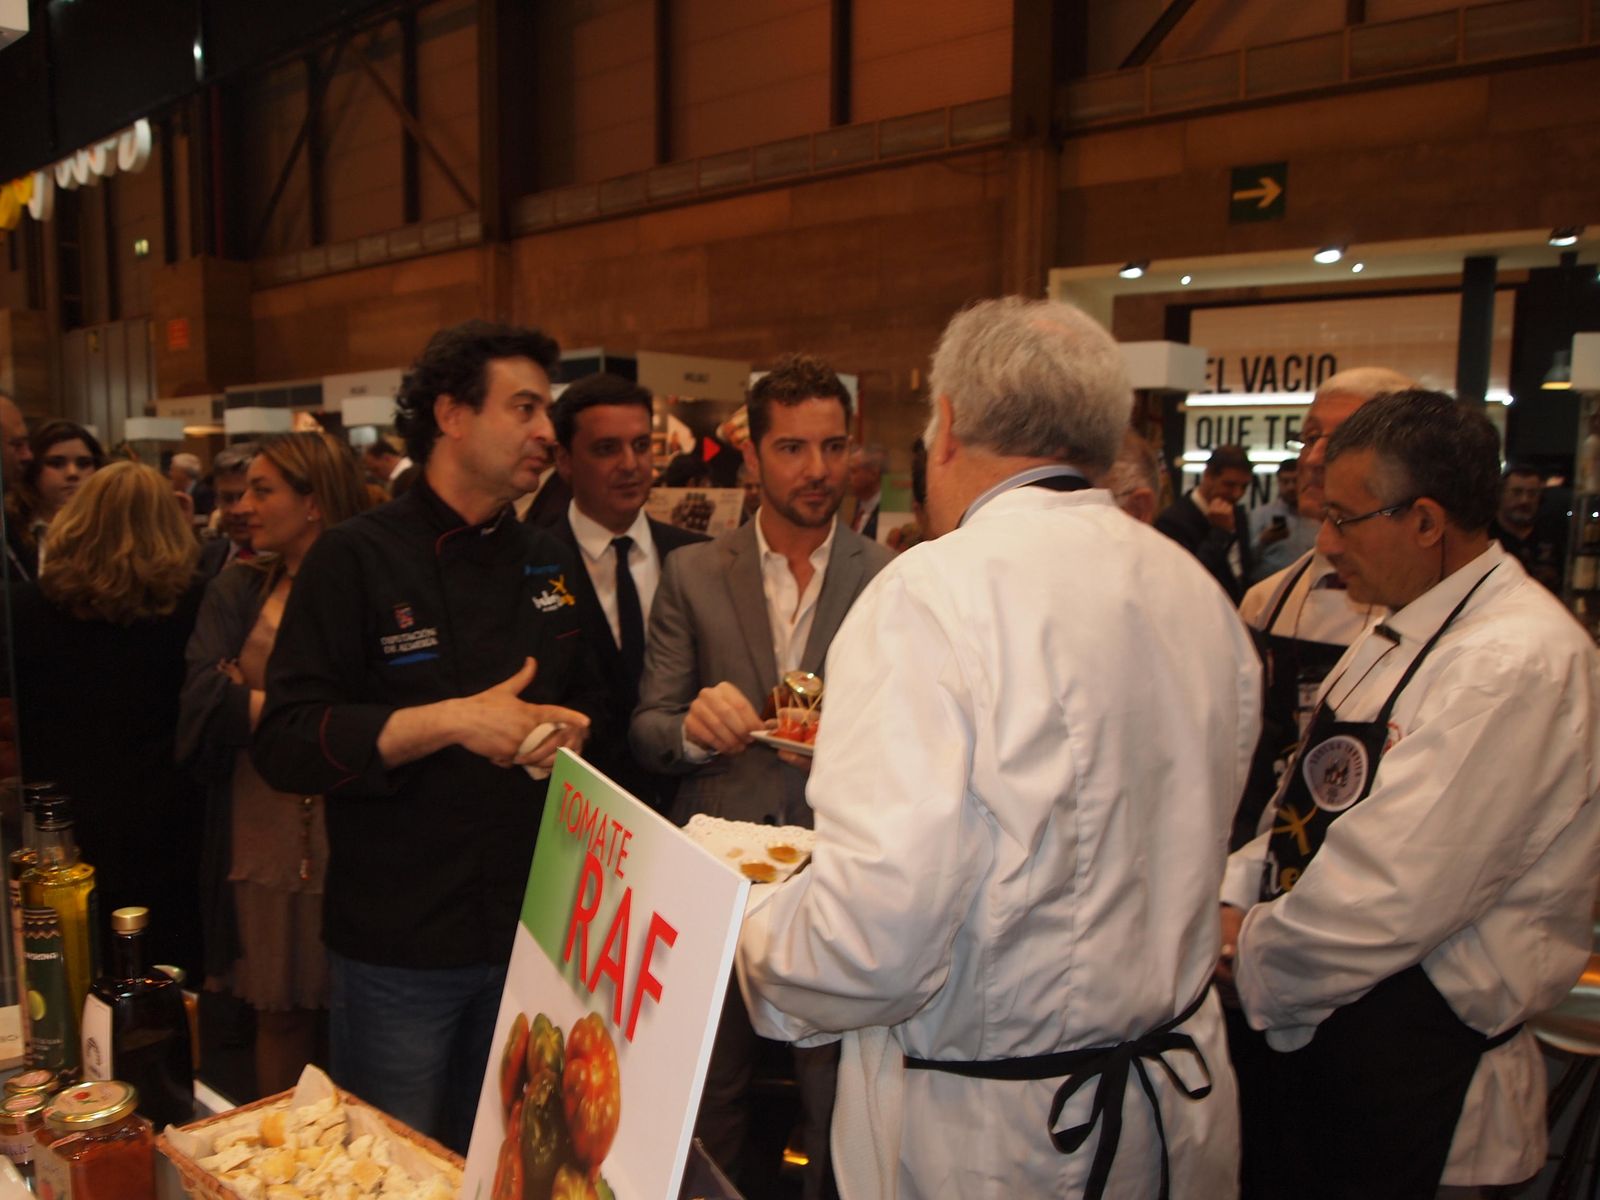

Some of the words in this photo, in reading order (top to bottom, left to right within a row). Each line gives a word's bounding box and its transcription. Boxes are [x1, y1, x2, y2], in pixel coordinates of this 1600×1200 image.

[1240, 352, 1337, 394] VACIO
[1195, 414, 1254, 451] QUE
[559, 780, 633, 880] TOMATE
[563, 850, 679, 1044] RAF
